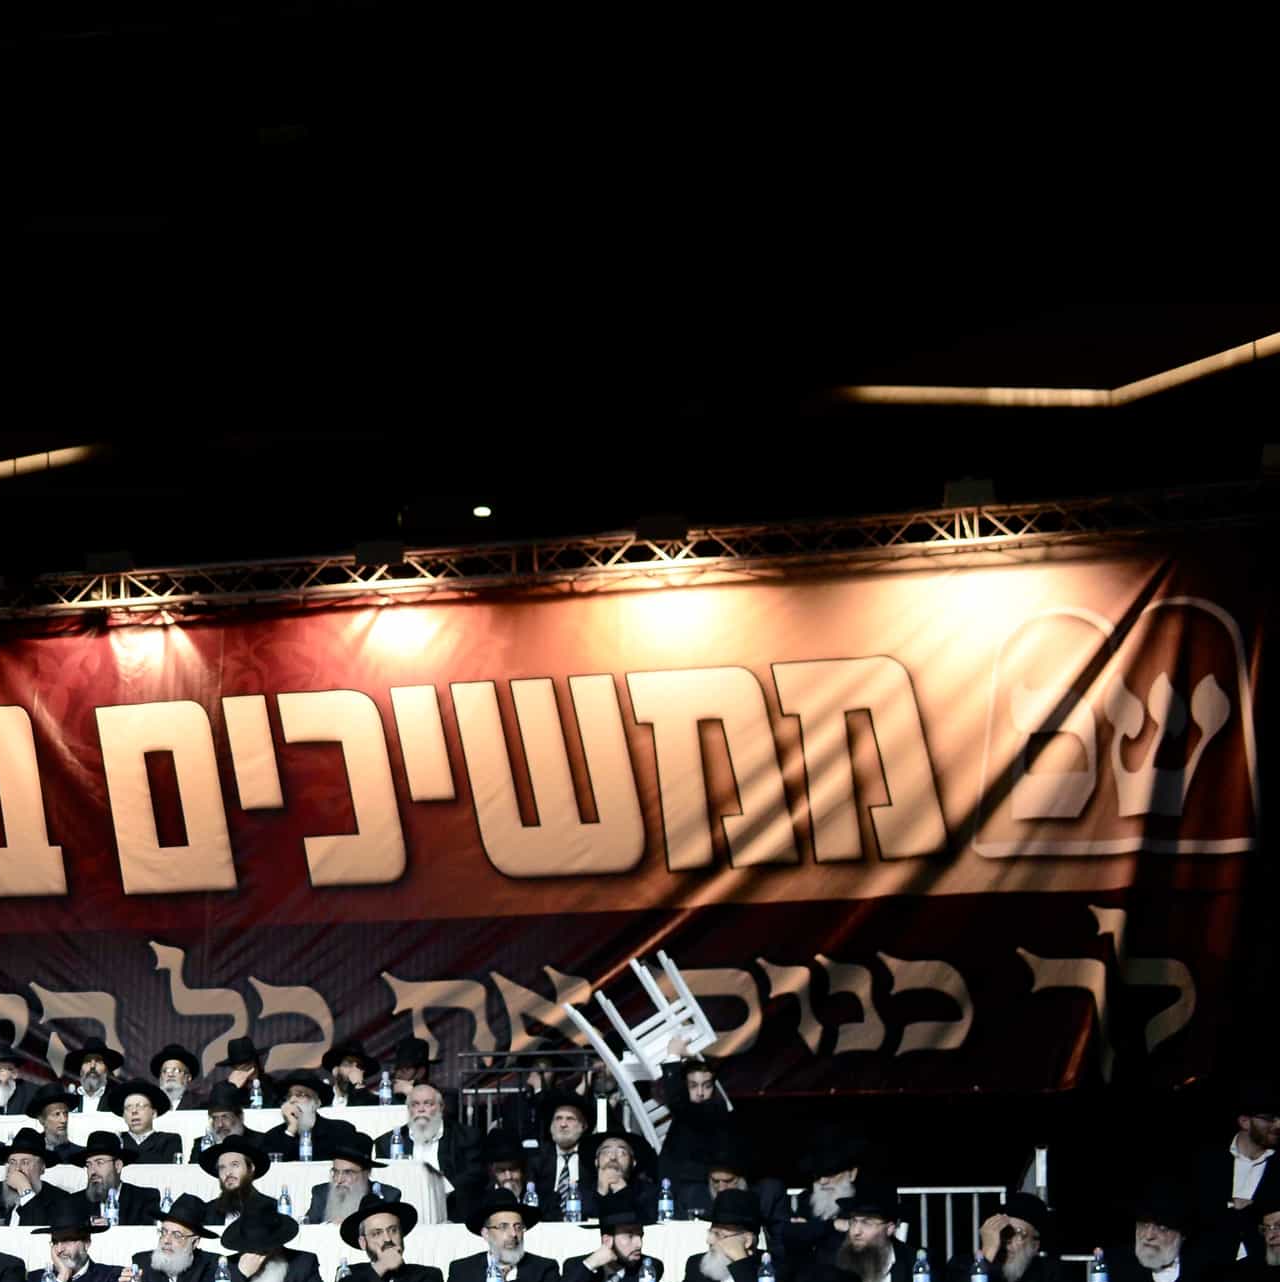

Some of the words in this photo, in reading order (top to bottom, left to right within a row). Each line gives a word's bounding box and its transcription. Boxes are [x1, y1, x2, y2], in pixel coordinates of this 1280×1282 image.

[95, 654, 948, 897] ממשיכים
[1011, 671, 1230, 820] שם
[149, 941, 335, 1077] כל
[381, 965, 607, 1067] את
[1018, 903, 1197, 1086] לך
